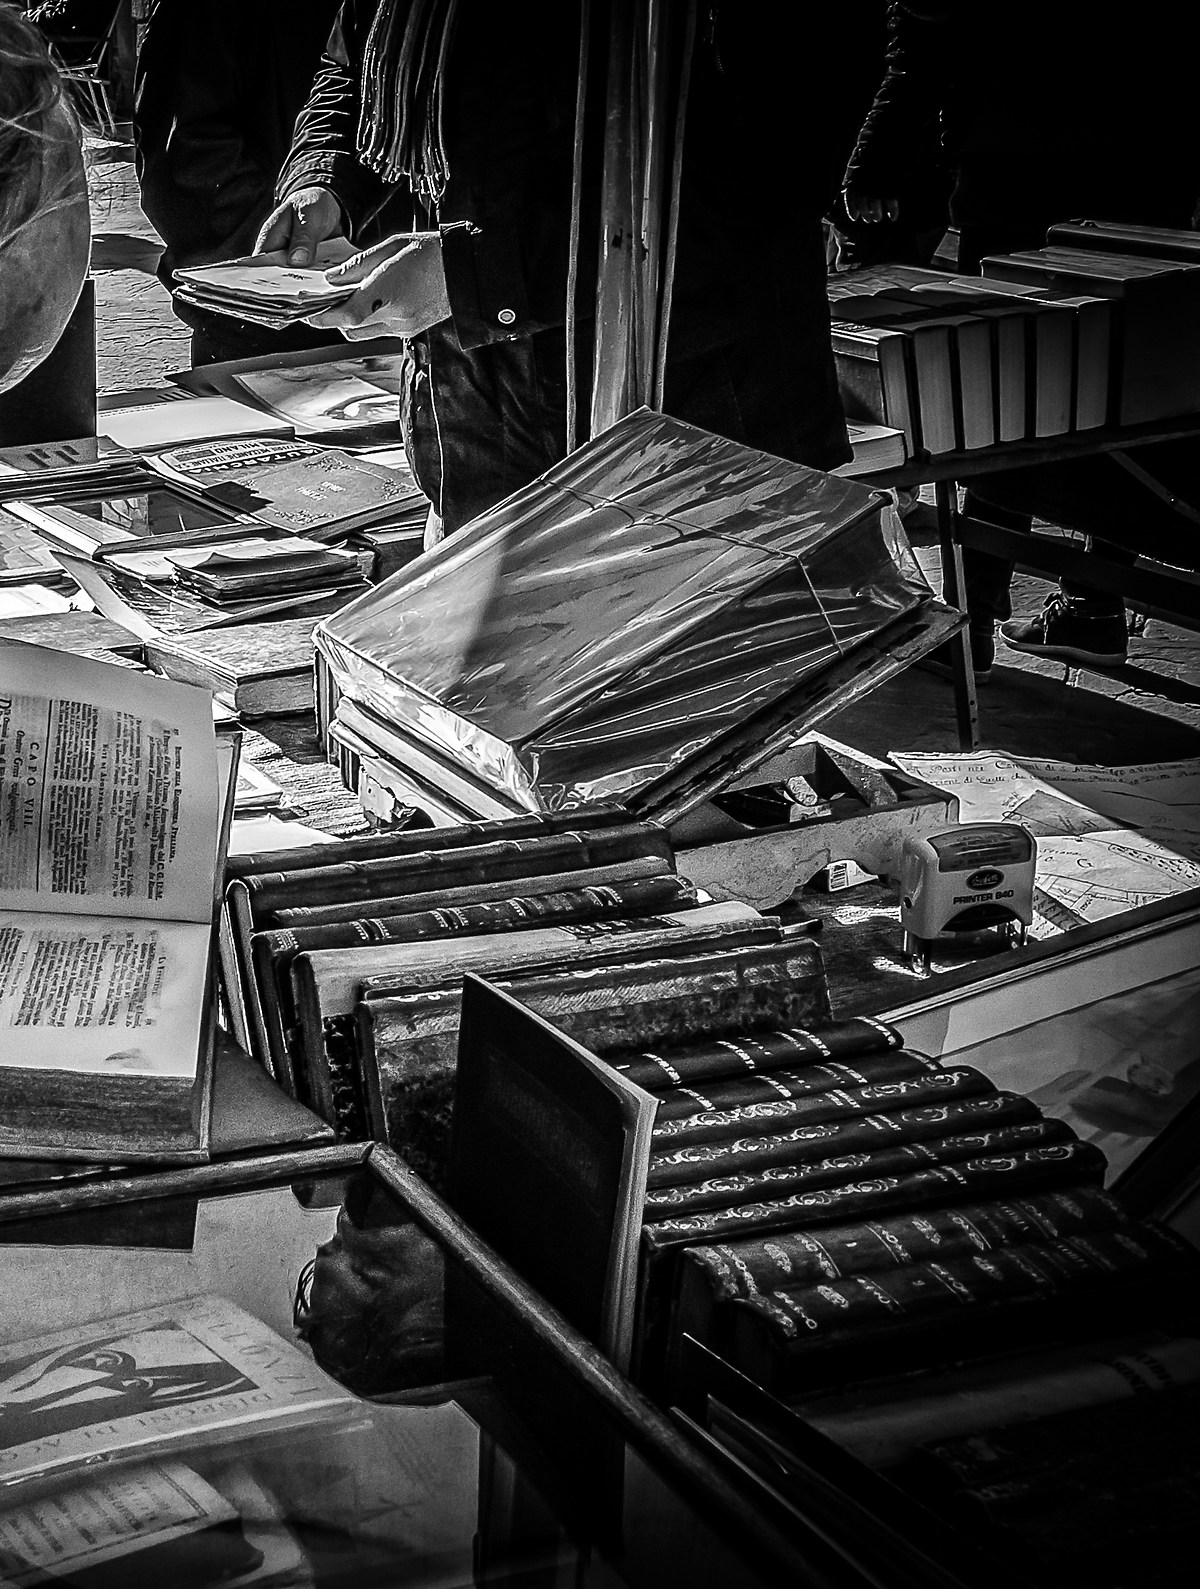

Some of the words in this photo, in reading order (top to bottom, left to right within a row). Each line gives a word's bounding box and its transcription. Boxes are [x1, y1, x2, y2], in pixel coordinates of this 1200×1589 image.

[26, 742, 40, 786] CAPO
[24, 798, 34, 828] VIII.
[953, 892, 993, 905] PRINTER
[137, 1391, 273, 1428] DISEGNI
